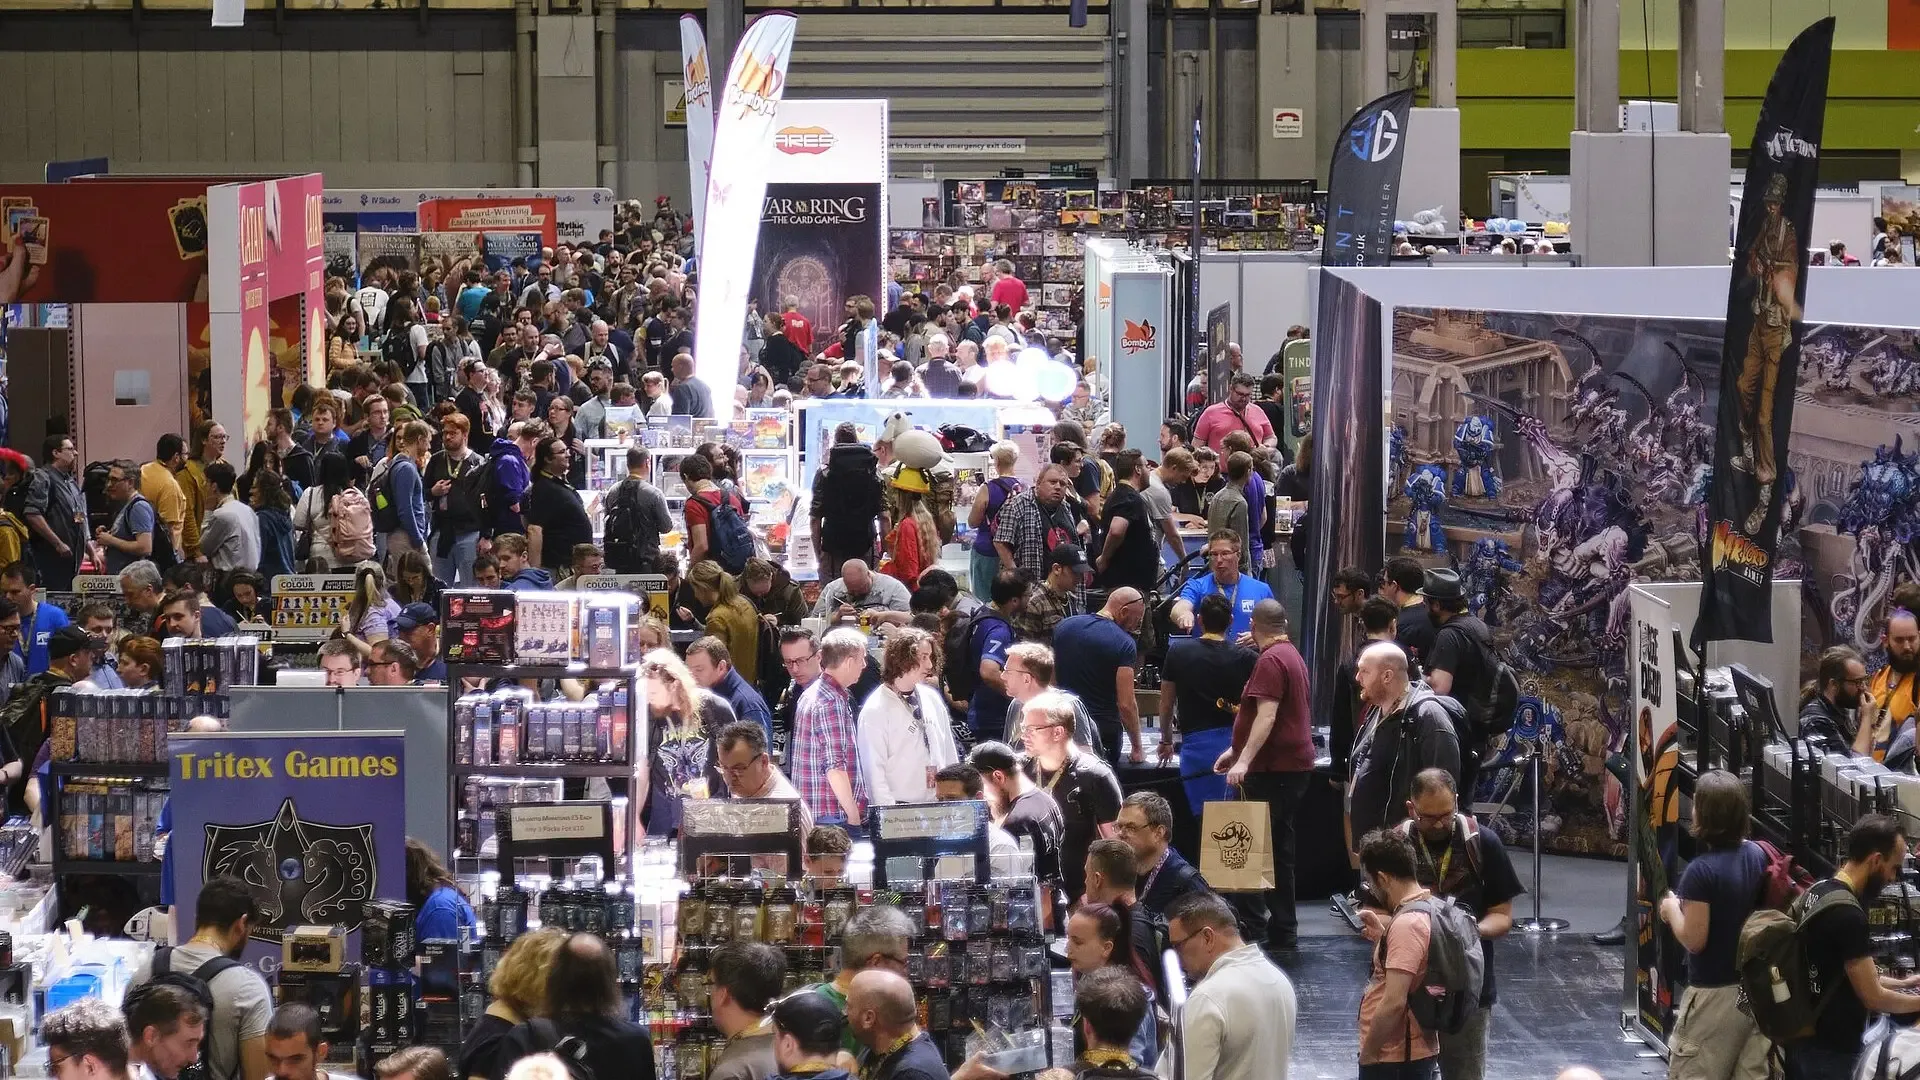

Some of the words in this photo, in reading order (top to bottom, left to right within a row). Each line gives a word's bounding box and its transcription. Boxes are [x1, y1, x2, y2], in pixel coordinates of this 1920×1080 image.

[774, 133, 834, 148] ARES
[946, 143, 985, 151] emergency
[371, 196, 379, 204] IV
[379, 195, 401, 204] Studio
[464, 207, 530, 219] Award-Winning
[808, 196, 867, 220] RING
[449, 219, 480, 228] Escape
[480, 217, 507, 226] Rooms
[508, 217, 516, 225] in
[527, 215, 541, 225] Box
[772, 215, 789, 225] THE
[789, 215, 814, 225] CARD
[814, 215, 841, 225] GAME
[1376, 183, 1391, 255] RETAILER
[240, 204, 264, 266] CATAN
[1120, 337, 1156, 349] Bombyx
[1712, 518, 1770, 573] WARLORD
[988, 639, 1002, 653] 7
[175, 751, 274, 780] Tritex
[284, 750, 398, 779] Games
